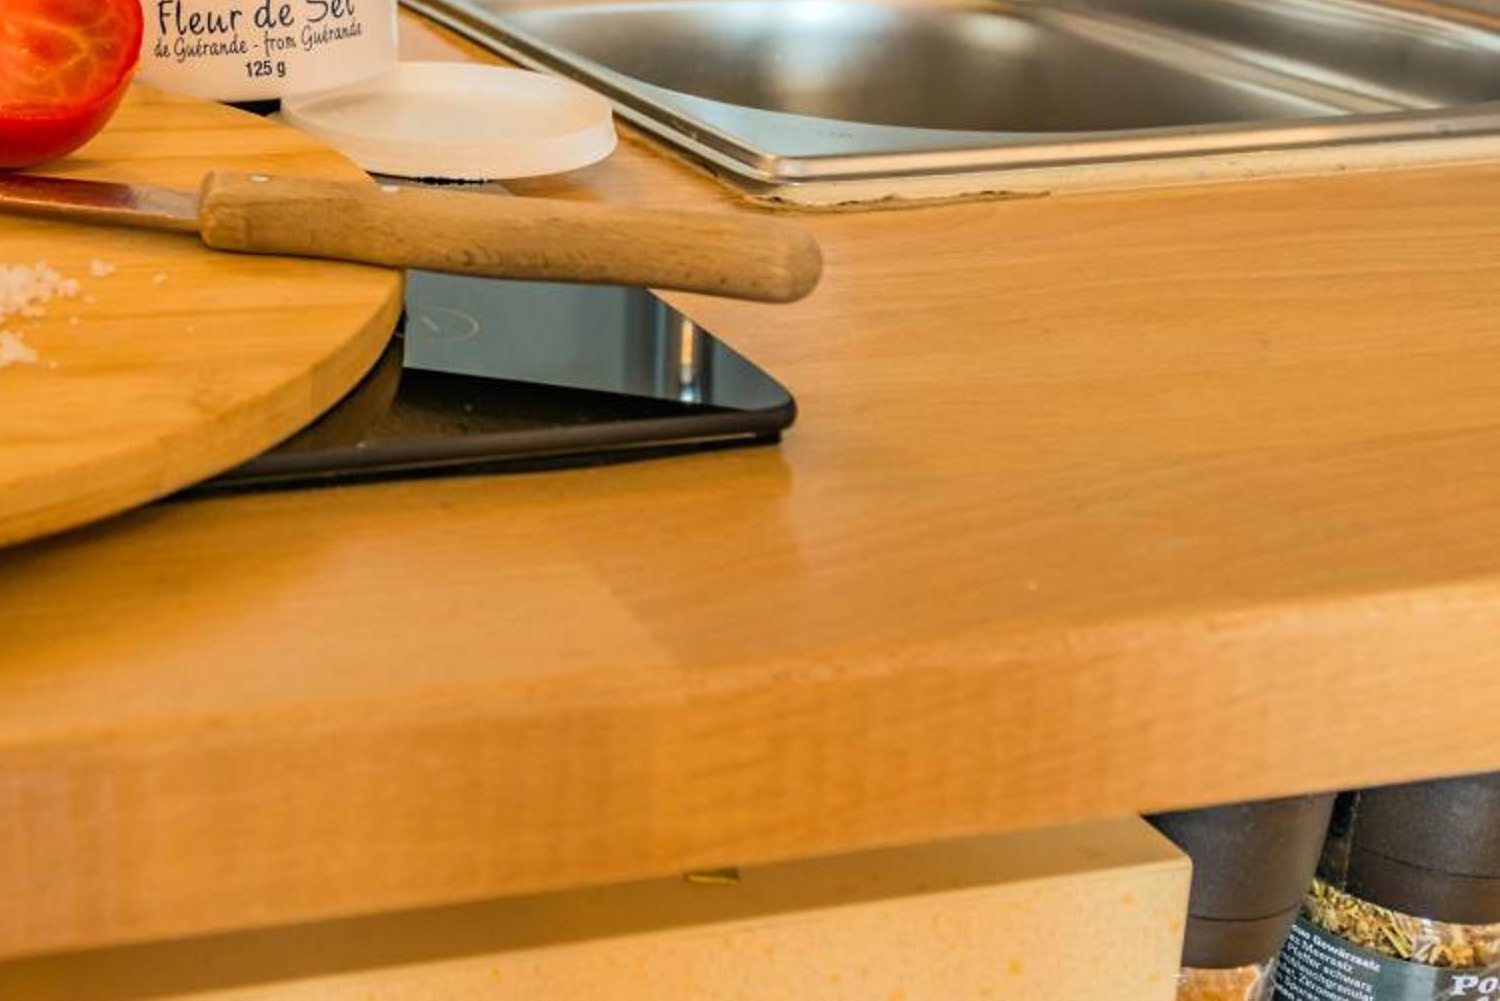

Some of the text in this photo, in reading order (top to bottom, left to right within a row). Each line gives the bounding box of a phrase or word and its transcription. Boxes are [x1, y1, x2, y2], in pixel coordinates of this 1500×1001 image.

[154, 40, 171, 59] de
[173, 33, 248, 63] Guérande
[263, 30, 297, 57] from
[245, 60, 287, 78] 125 g
[1450, 975, 1500, 996] Po
